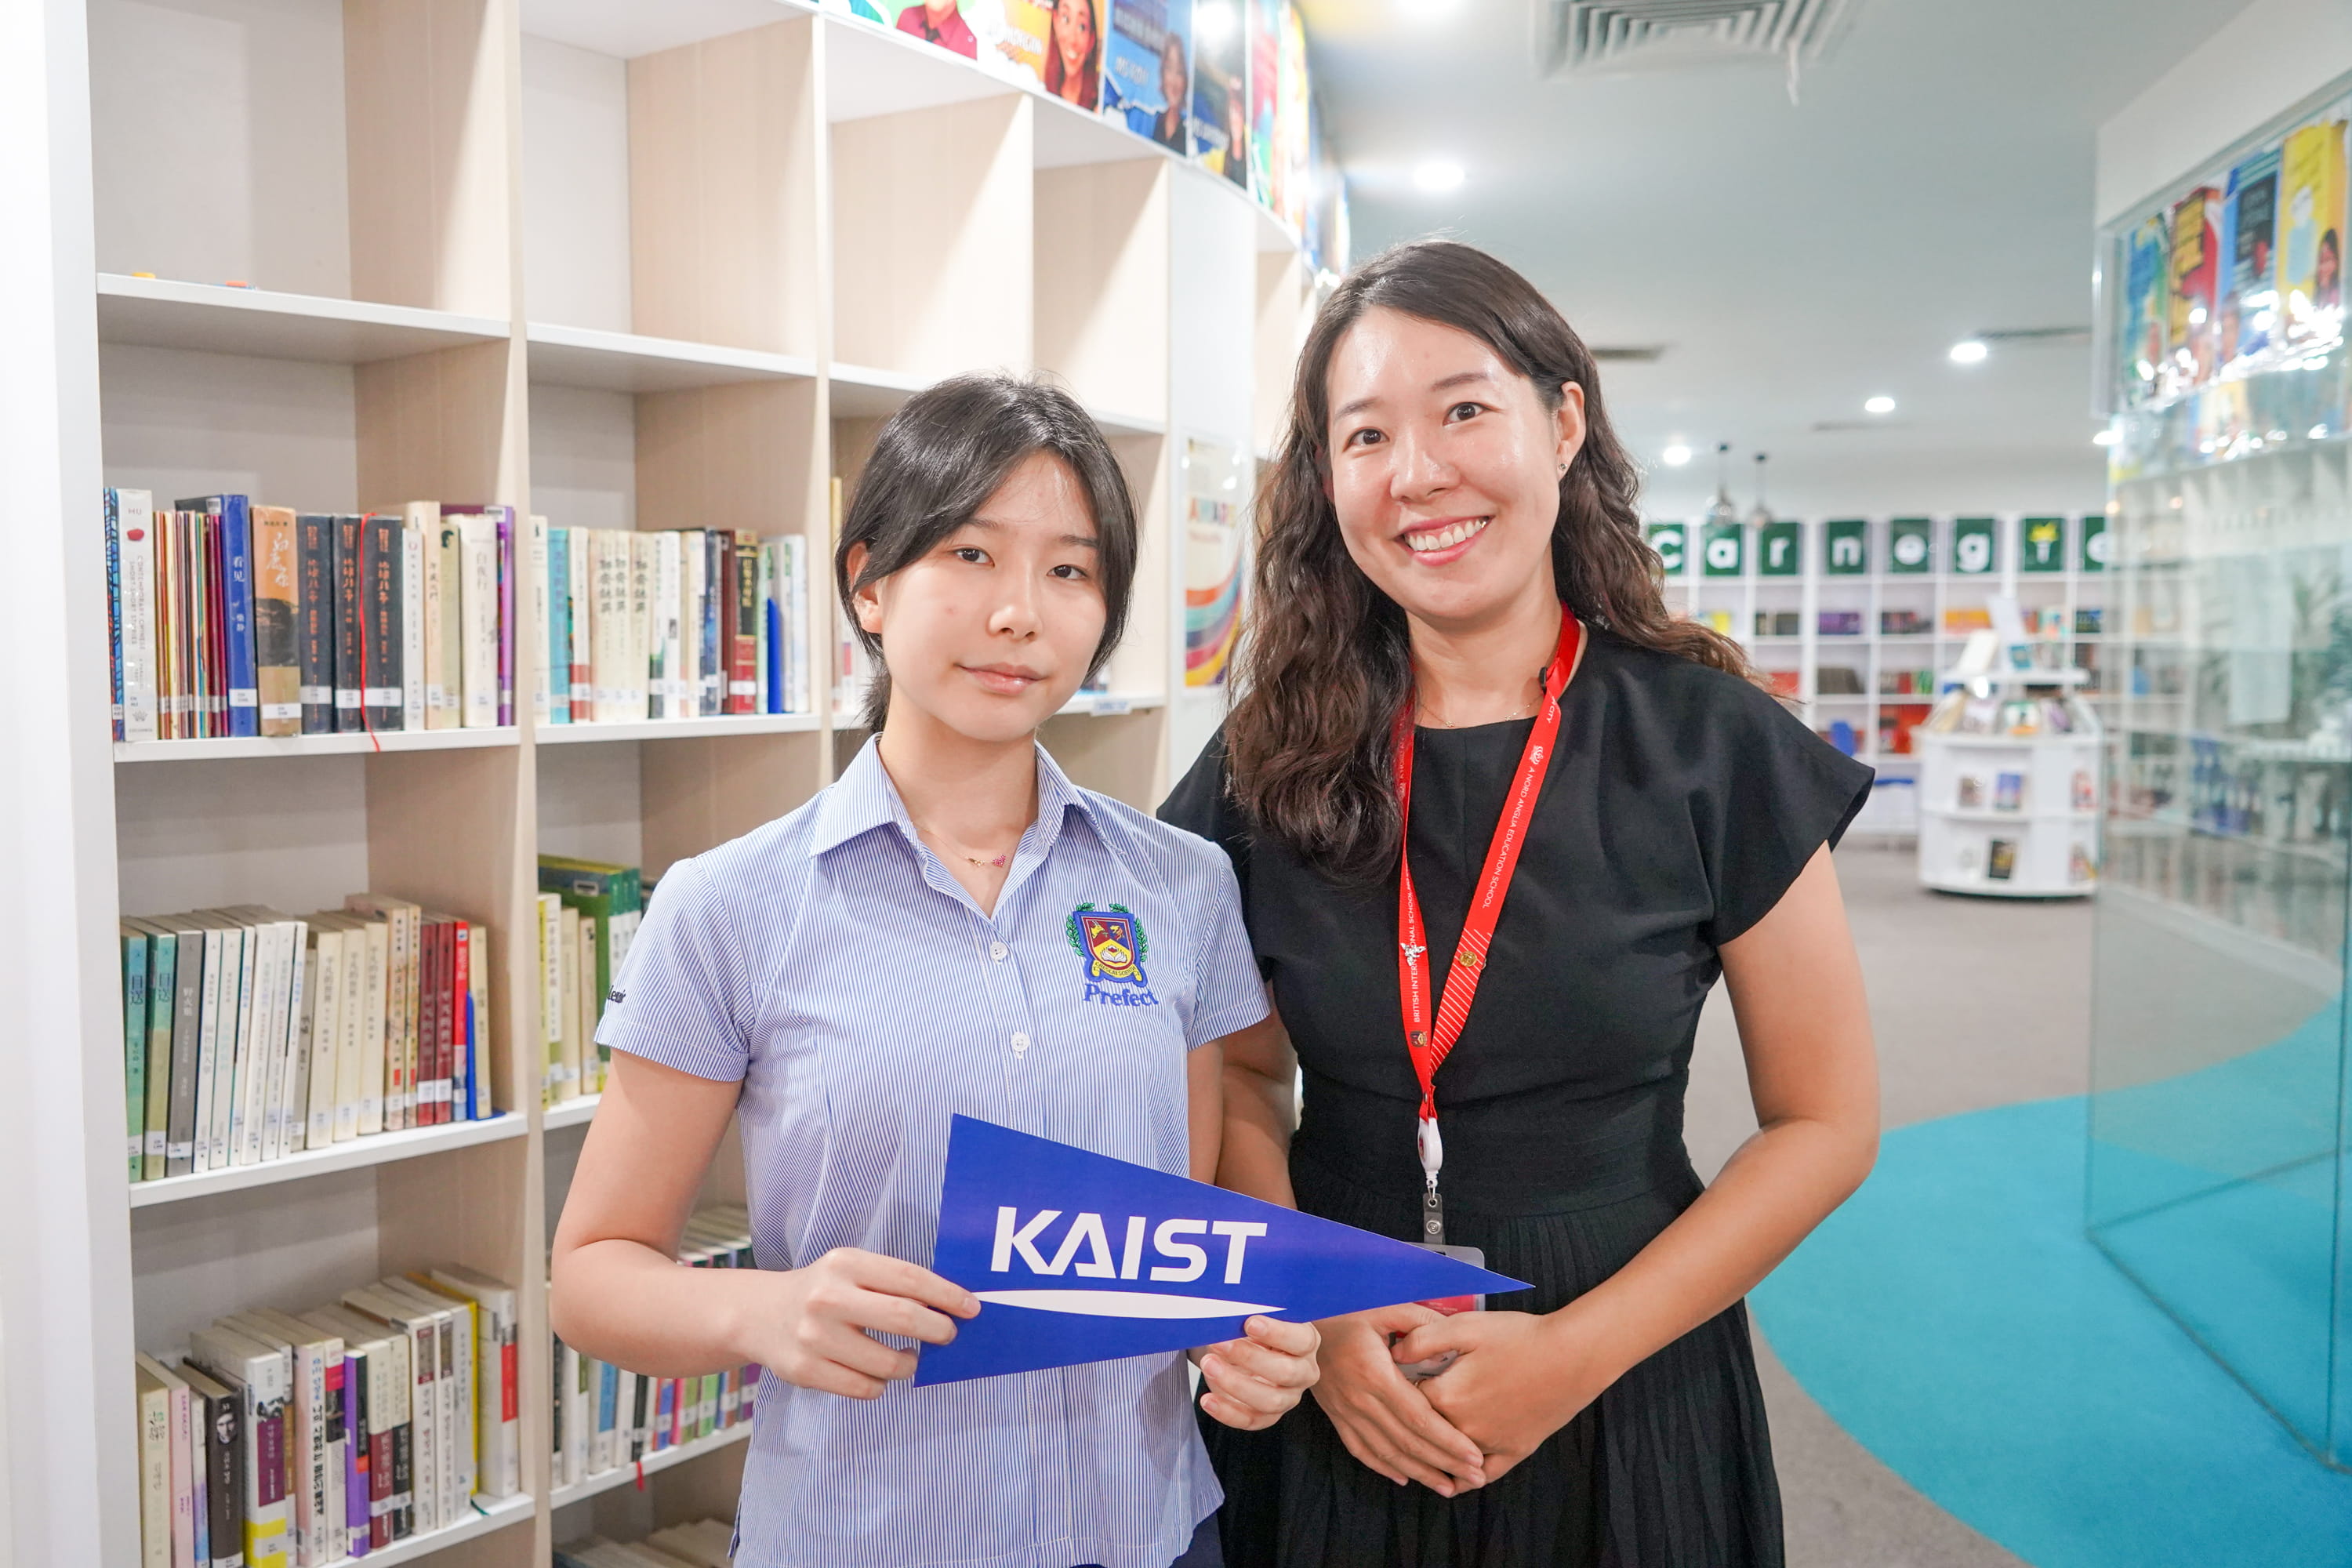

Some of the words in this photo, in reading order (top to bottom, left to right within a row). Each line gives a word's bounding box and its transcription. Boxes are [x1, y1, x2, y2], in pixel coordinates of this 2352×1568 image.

[234, 556, 245, 583] 看见
[1520, 773, 1534, 798] NORD
[1509, 798, 1524, 828] ANGLIA
[1495, 829, 1515, 876] EDUCATION
[1483, 876, 1499, 909] SCHOOL
[1408, 925, 1420, 990] INTERNONAL
[129, 975, 144, 1006] 目送
[156, 972, 171, 1003] 目送
[1083, 983, 1160, 1007] Prefect
[991, 1206, 1268, 1284] KAIST
